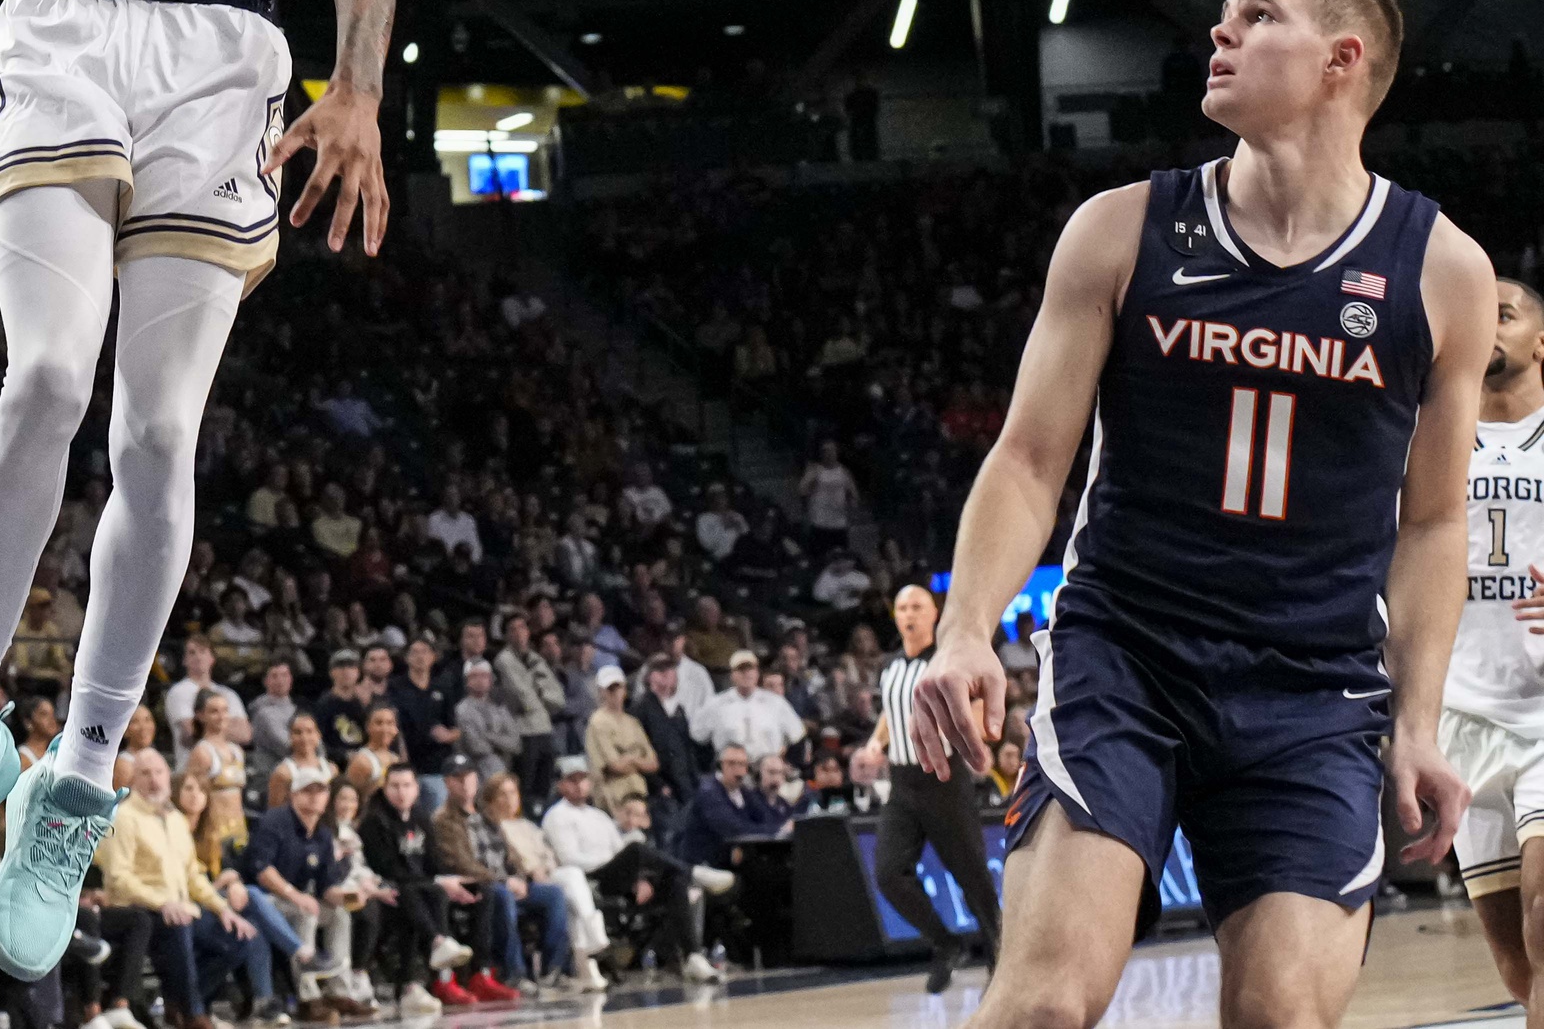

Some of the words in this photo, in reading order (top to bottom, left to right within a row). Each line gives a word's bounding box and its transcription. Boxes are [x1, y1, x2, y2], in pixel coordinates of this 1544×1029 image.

[213, 189, 242, 203] adidas
[1175, 222, 1186, 234] 15
[1194, 224, 1206, 237] 41
[1146, 315, 1385, 388] VIRGINIA
[1221, 386, 1296, 520] 11
[1466, 476, 1543, 502] ORGI
[1488, 508, 1509, 567] 1
